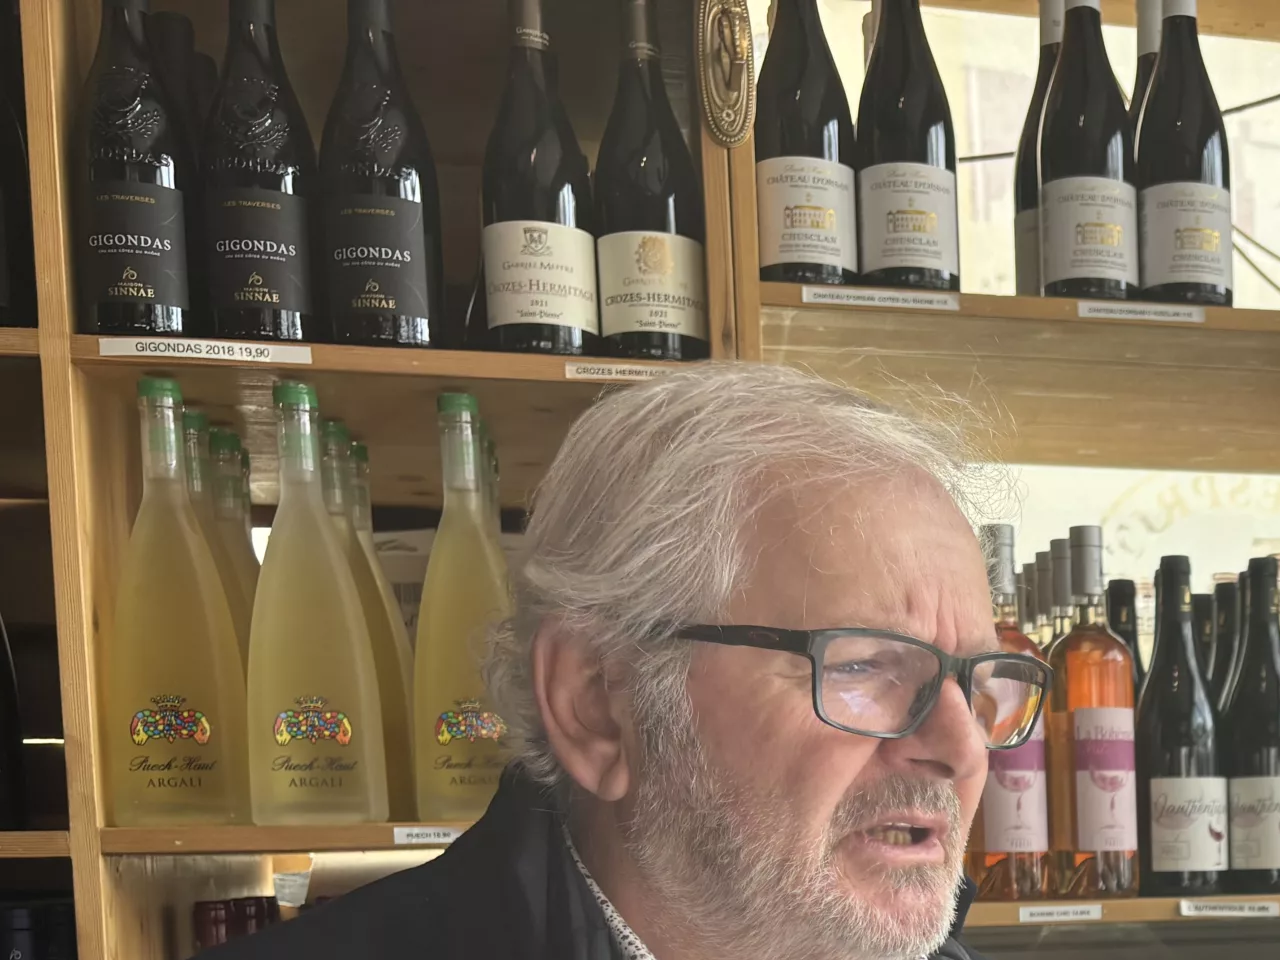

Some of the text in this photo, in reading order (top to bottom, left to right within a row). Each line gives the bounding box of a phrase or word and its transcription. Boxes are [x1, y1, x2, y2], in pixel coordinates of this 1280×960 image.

[89, 234, 172, 251] GIGONDAS
[216, 239, 296, 256] GIGONDAS
[334, 247, 411, 262] GIGONDAS
[108, 286, 155, 298] SINNAE
[234, 291, 280, 303] SINNAE
[351, 298, 396, 309] SINNAE
[135, 341, 270, 359] GIGONDAS 2018 19,90
[576, 366, 613, 376] CROZES
[147, 776, 202, 788] ARGALI
[288, 776, 343, 788] ARGALI
